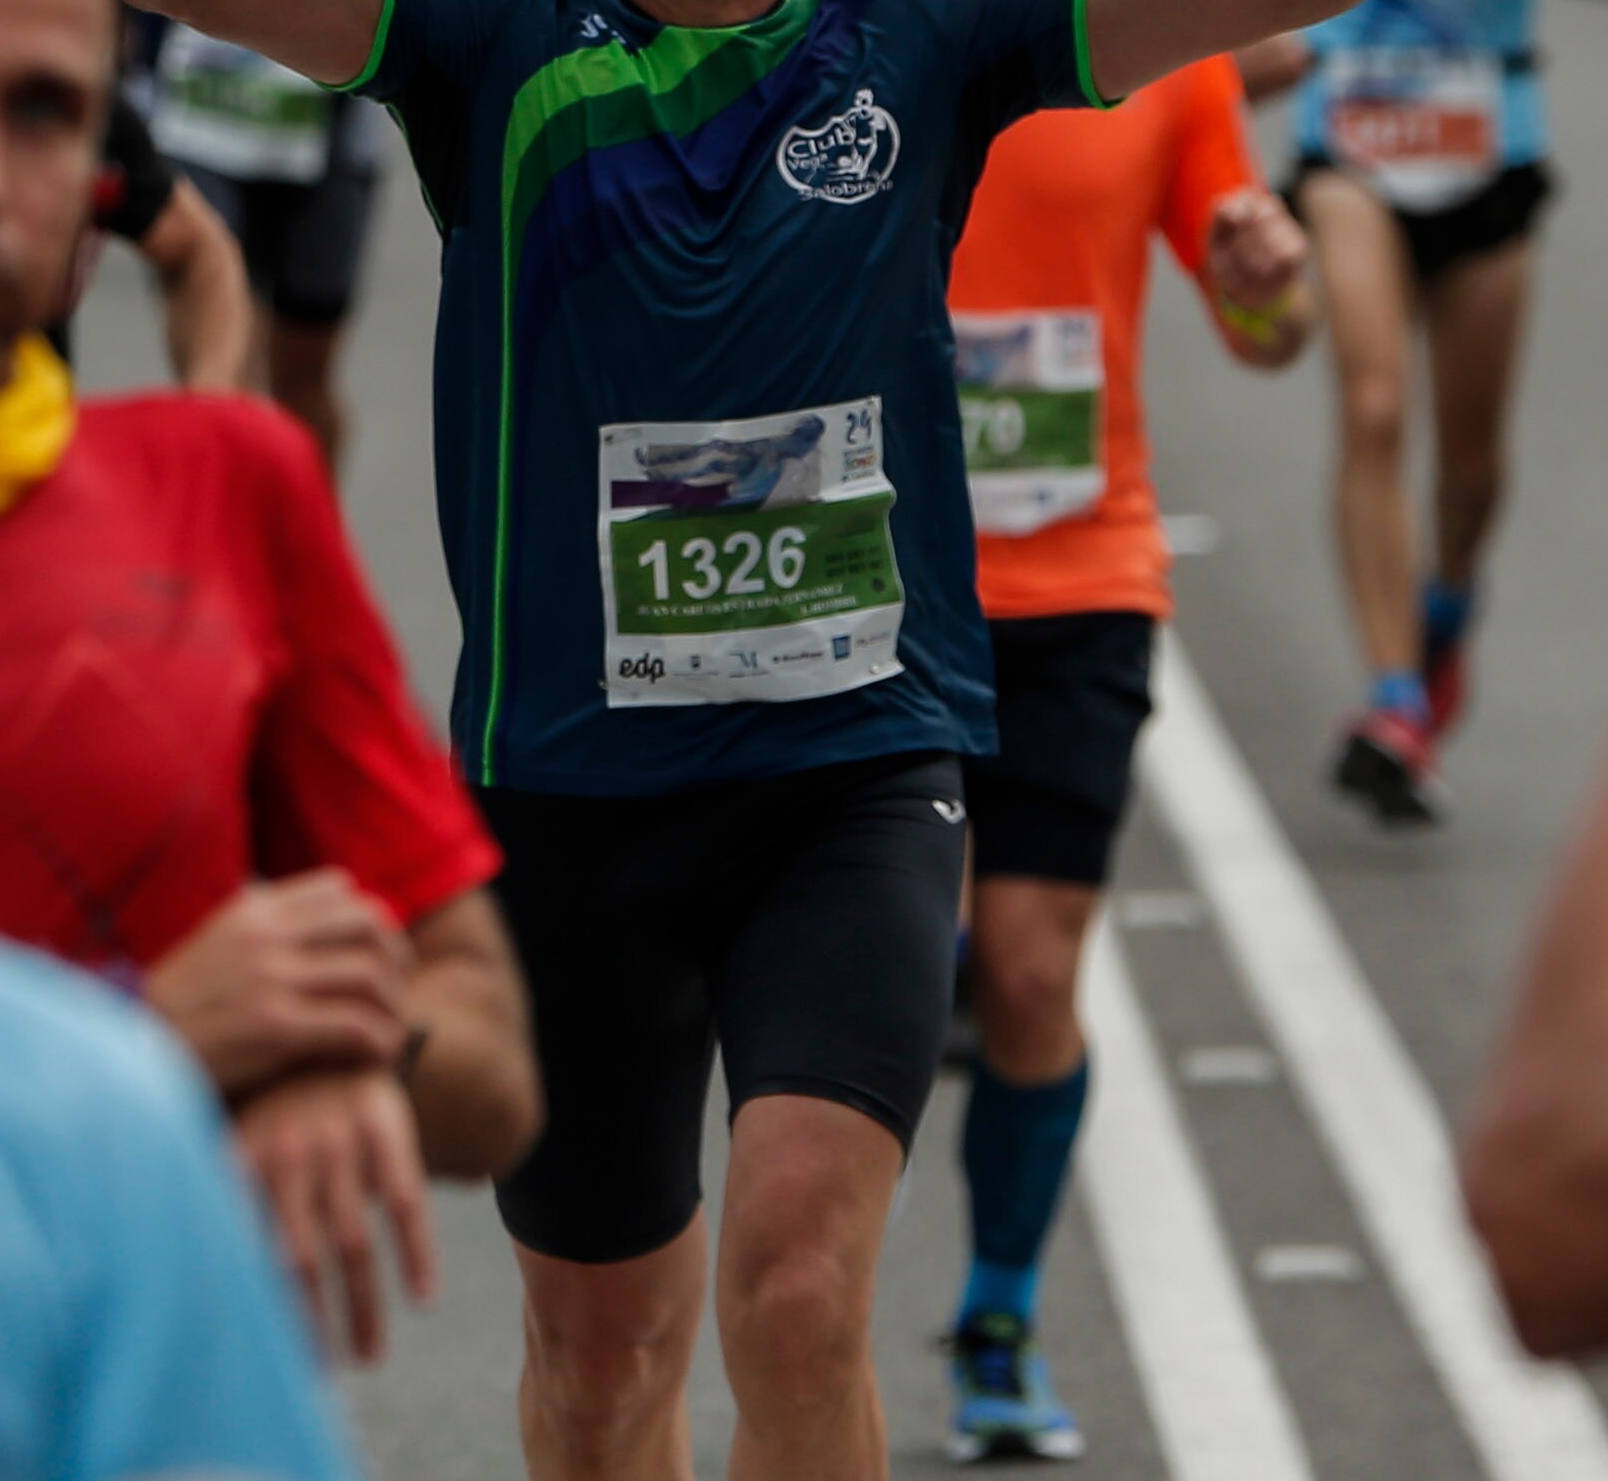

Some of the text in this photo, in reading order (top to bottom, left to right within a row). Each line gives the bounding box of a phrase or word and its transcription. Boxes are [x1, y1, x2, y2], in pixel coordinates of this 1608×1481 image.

[787, 127, 856, 158] Club
[638, 526, 806, 601] 1326
[619, 652, 666, 683] edp
